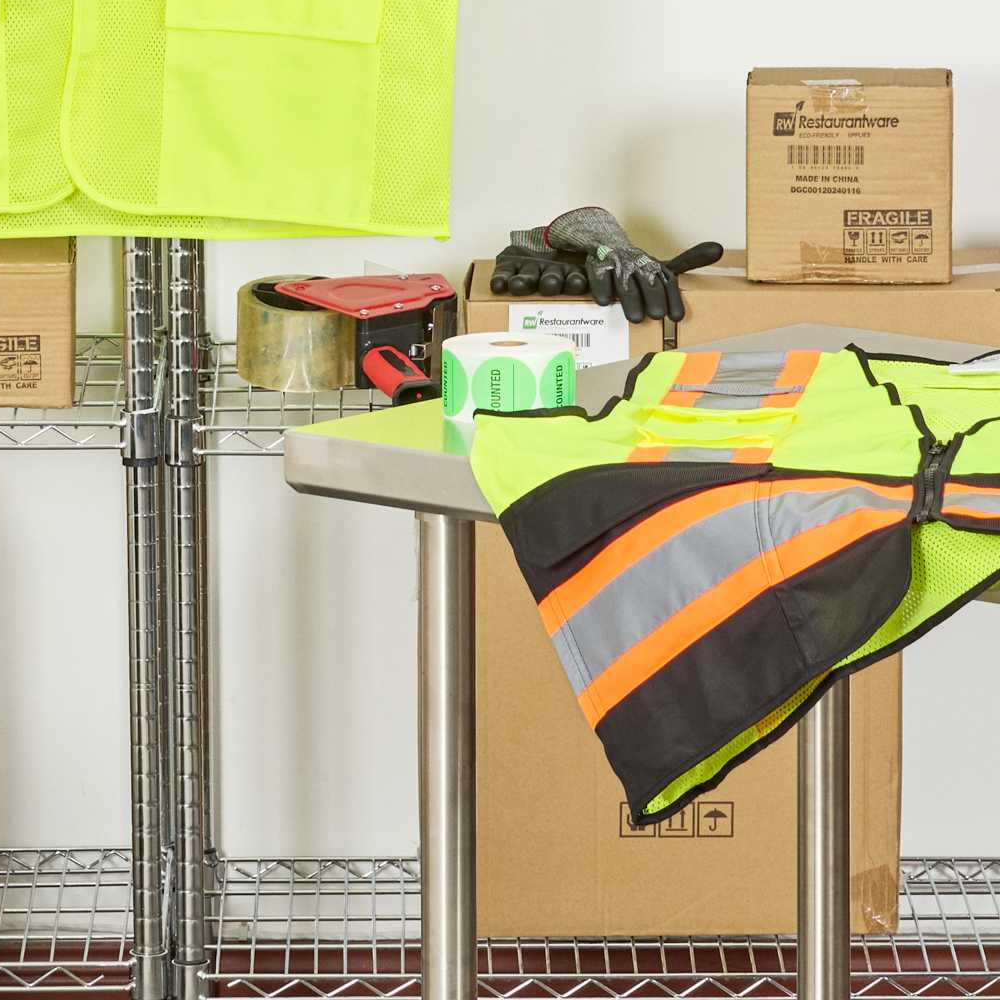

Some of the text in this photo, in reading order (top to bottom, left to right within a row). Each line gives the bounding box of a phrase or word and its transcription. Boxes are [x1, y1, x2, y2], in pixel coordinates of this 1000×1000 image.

[776, 114, 899, 131] RW Restaurantware
[795, 175, 859, 183] MADE IN CHINA
[790, 186, 861, 195] DGC00120240116
[847, 210, 930, 226] FRAGILE
[539, 318, 605, 326] Restaurantware
[15, 381, 38, 389] CARE
[490, 369, 501, 411] OUNTED
[555, 364, 564, 408] OUNTED
